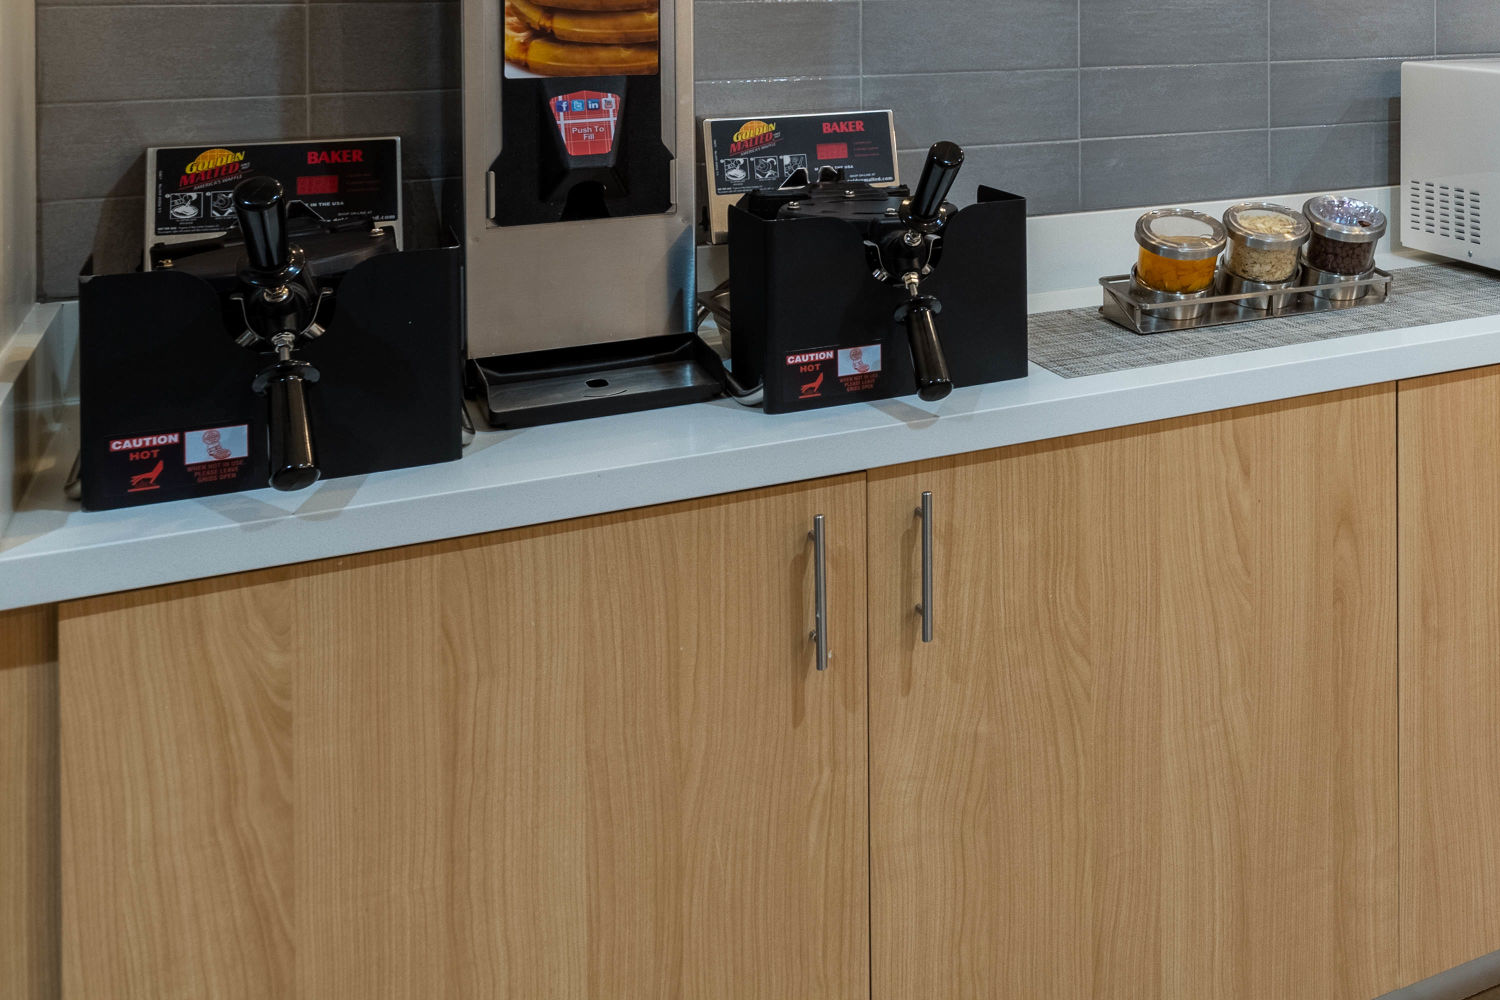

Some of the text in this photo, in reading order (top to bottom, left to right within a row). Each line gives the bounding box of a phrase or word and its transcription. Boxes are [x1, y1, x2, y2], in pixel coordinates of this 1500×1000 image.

[733, 121, 776, 143] GOLDEN
[822, 120, 865, 134] BAKER
[729, 132, 774, 153] MALTED
[185, 151, 246, 174] GOLDEN
[307, 149, 365, 165] BAKER
[179, 162, 241, 187] MALTED
[787, 351, 833, 364] CAUTION
[800, 363, 821, 373] HOT
[111, 433, 179, 450] CAUTION
[129, 449, 160, 461] HOT
[194, 466, 239, 477] PLEASE LEAVE
